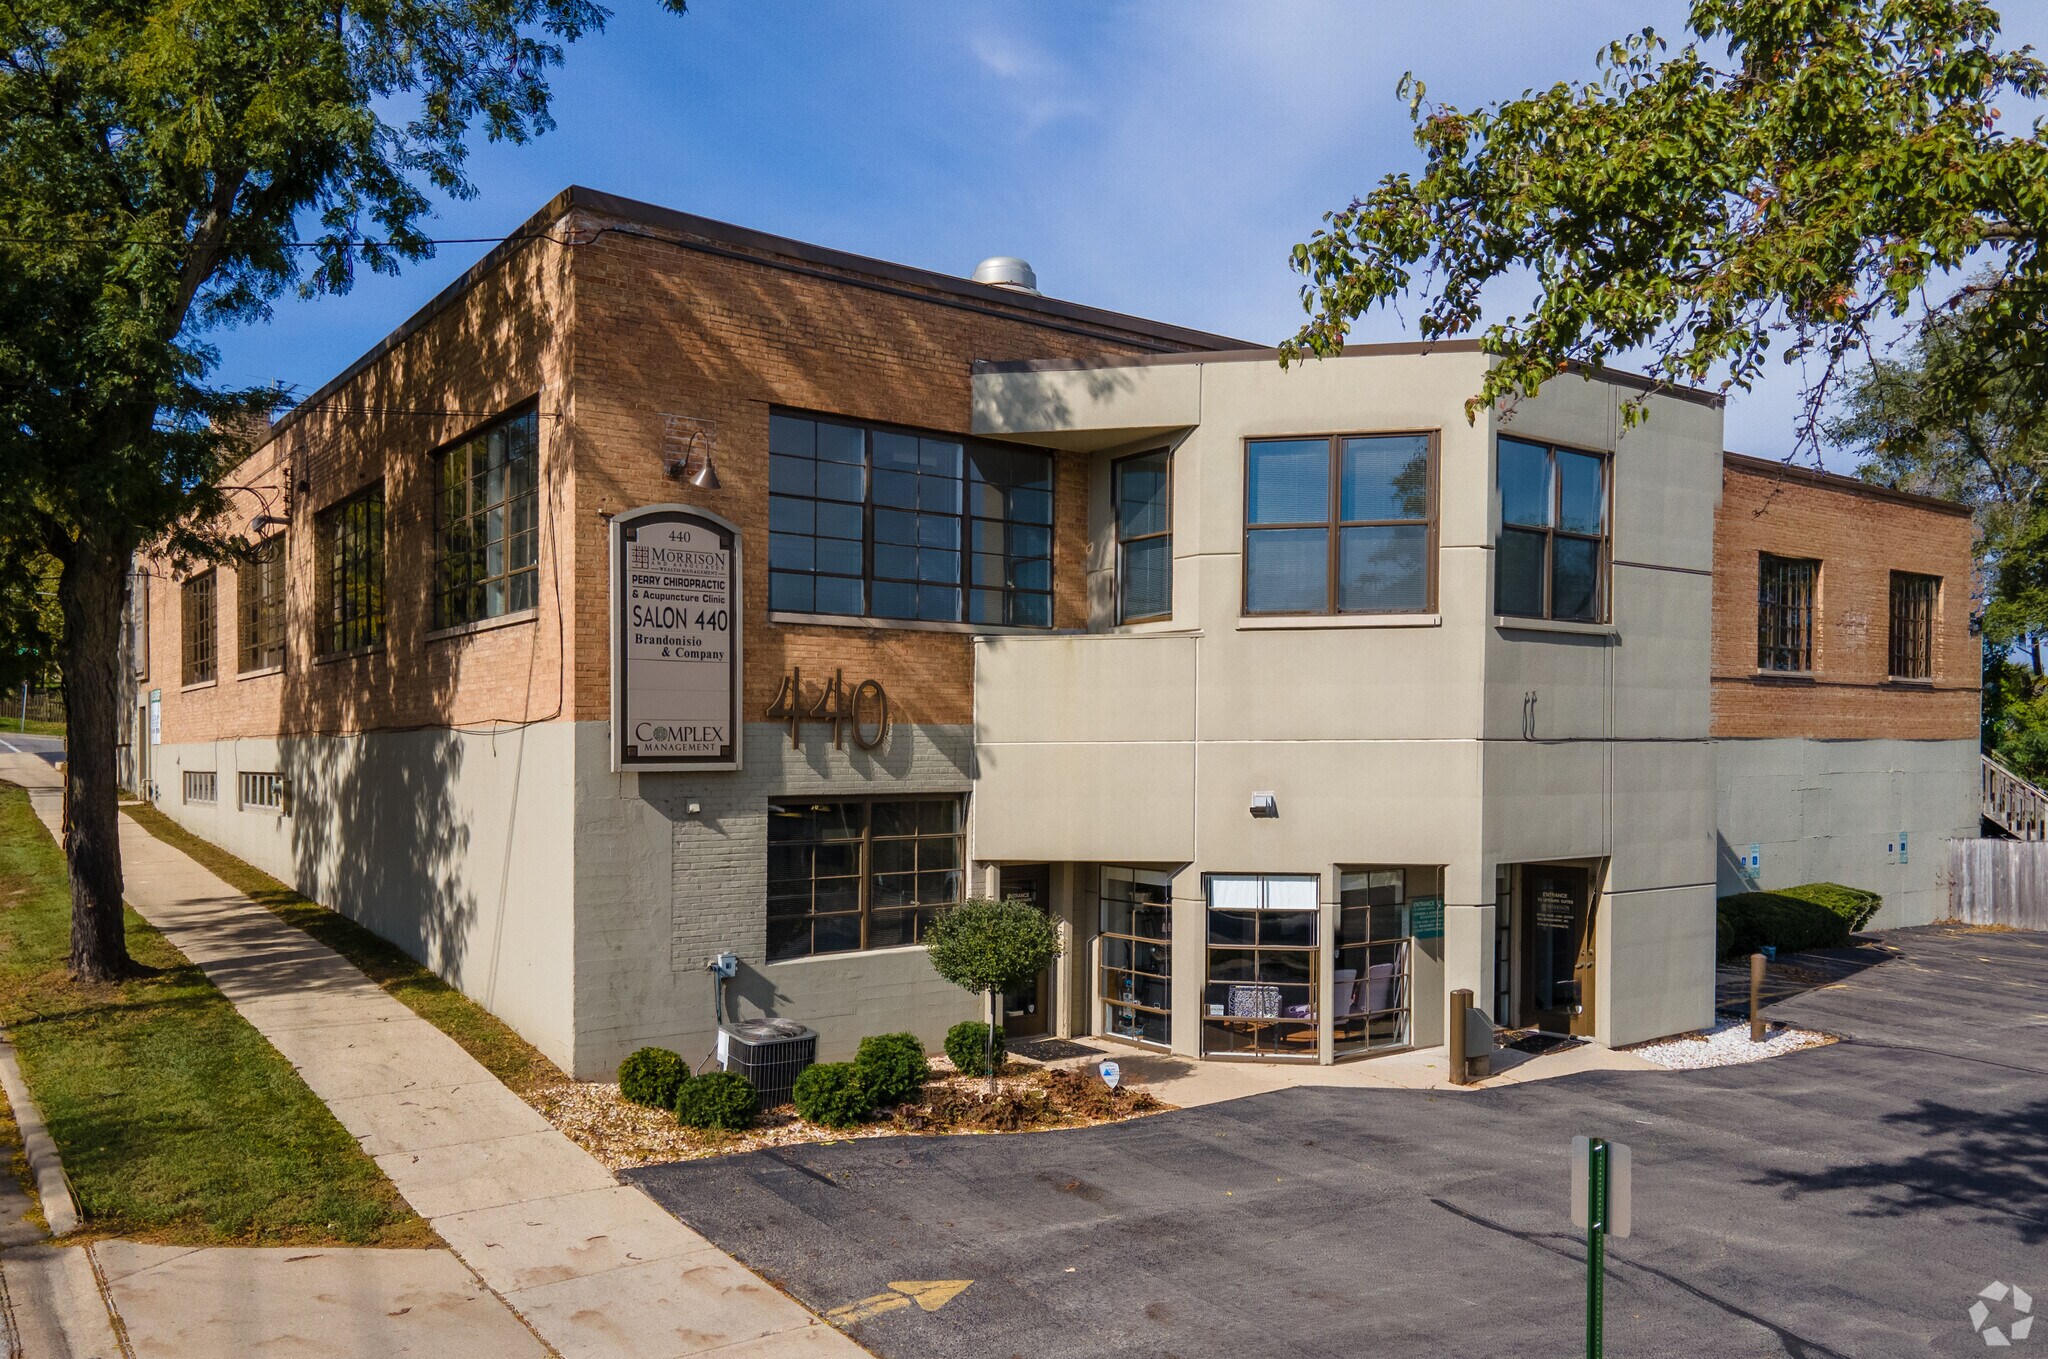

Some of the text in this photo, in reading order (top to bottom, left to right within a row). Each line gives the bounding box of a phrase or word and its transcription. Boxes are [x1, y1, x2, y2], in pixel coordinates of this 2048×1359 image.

[668, 530, 691, 543] 440
[651, 547, 726, 566] MORRISON
[672, 562, 725, 571] ASSOCIATES
[681, 568, 718, 576] MANAGEMENT
[631, 574, 726, 590] PERRY CHIROPRACTIC
[631, 589, 726, 604] & Acupuncture Clinic
[633, 604, 728, 631] SALON 440
[635, 633, 702, 646] Brandonisio
[661, 646, 725, 661] & Company
[766, 666, 888, 751] 440
[635, 722, 723, 742] COMPLEX
[644, 743, 716, 751] MANAGEMENT
[1542, 891, 1568, 899] ENTRANCE
